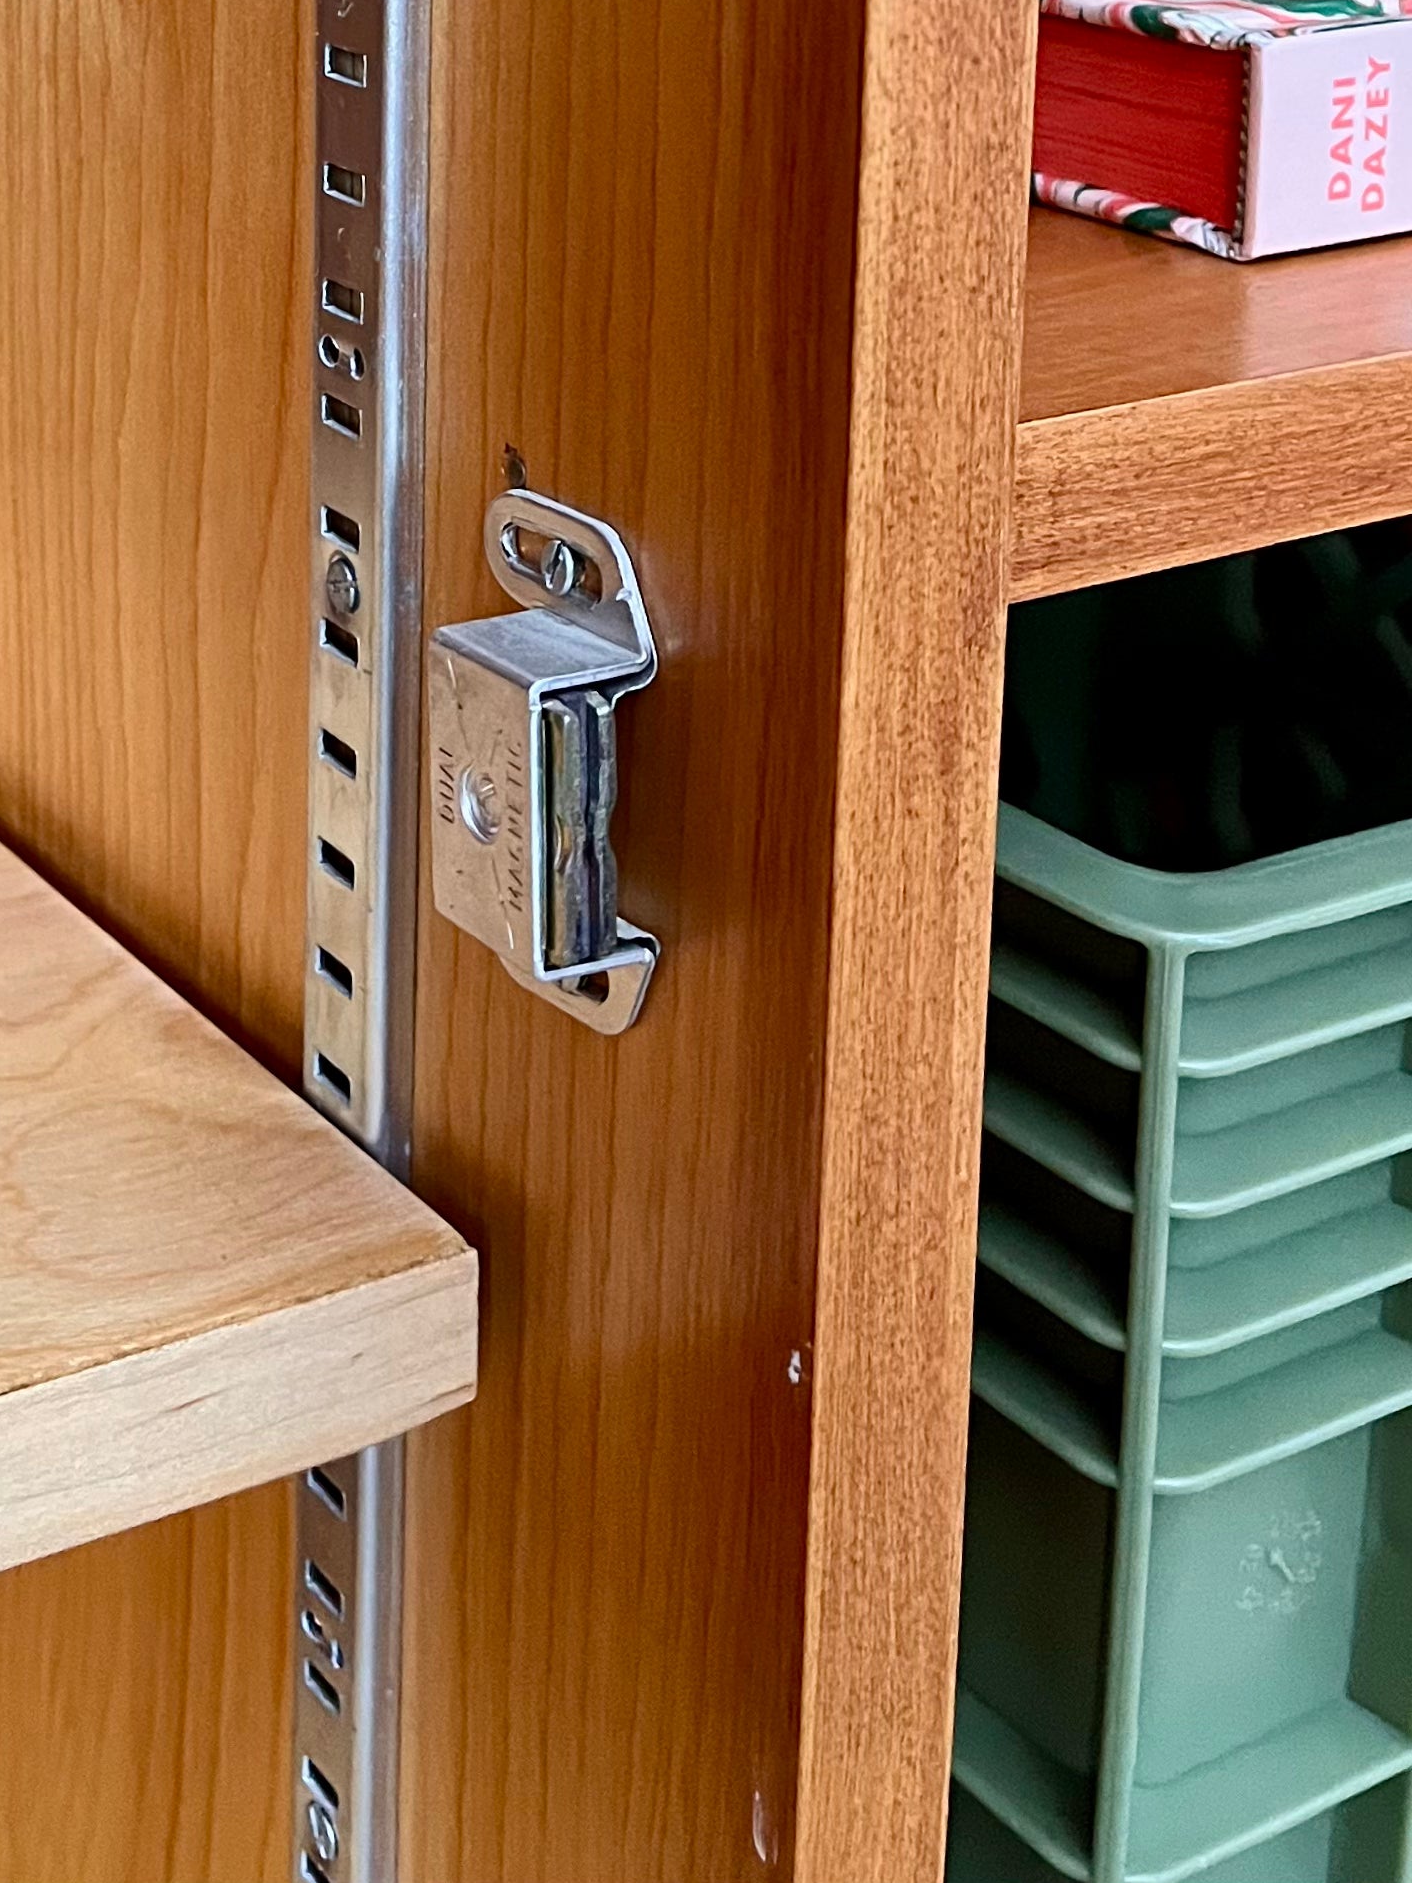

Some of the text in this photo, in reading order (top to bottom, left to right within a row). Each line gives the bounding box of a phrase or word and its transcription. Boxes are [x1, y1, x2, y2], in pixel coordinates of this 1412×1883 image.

[1328, 77, 1356, 201] DANI
[1361, 56, 1391, 212] DAZEY
[507, 742, 523, 913] MAGNETIC
